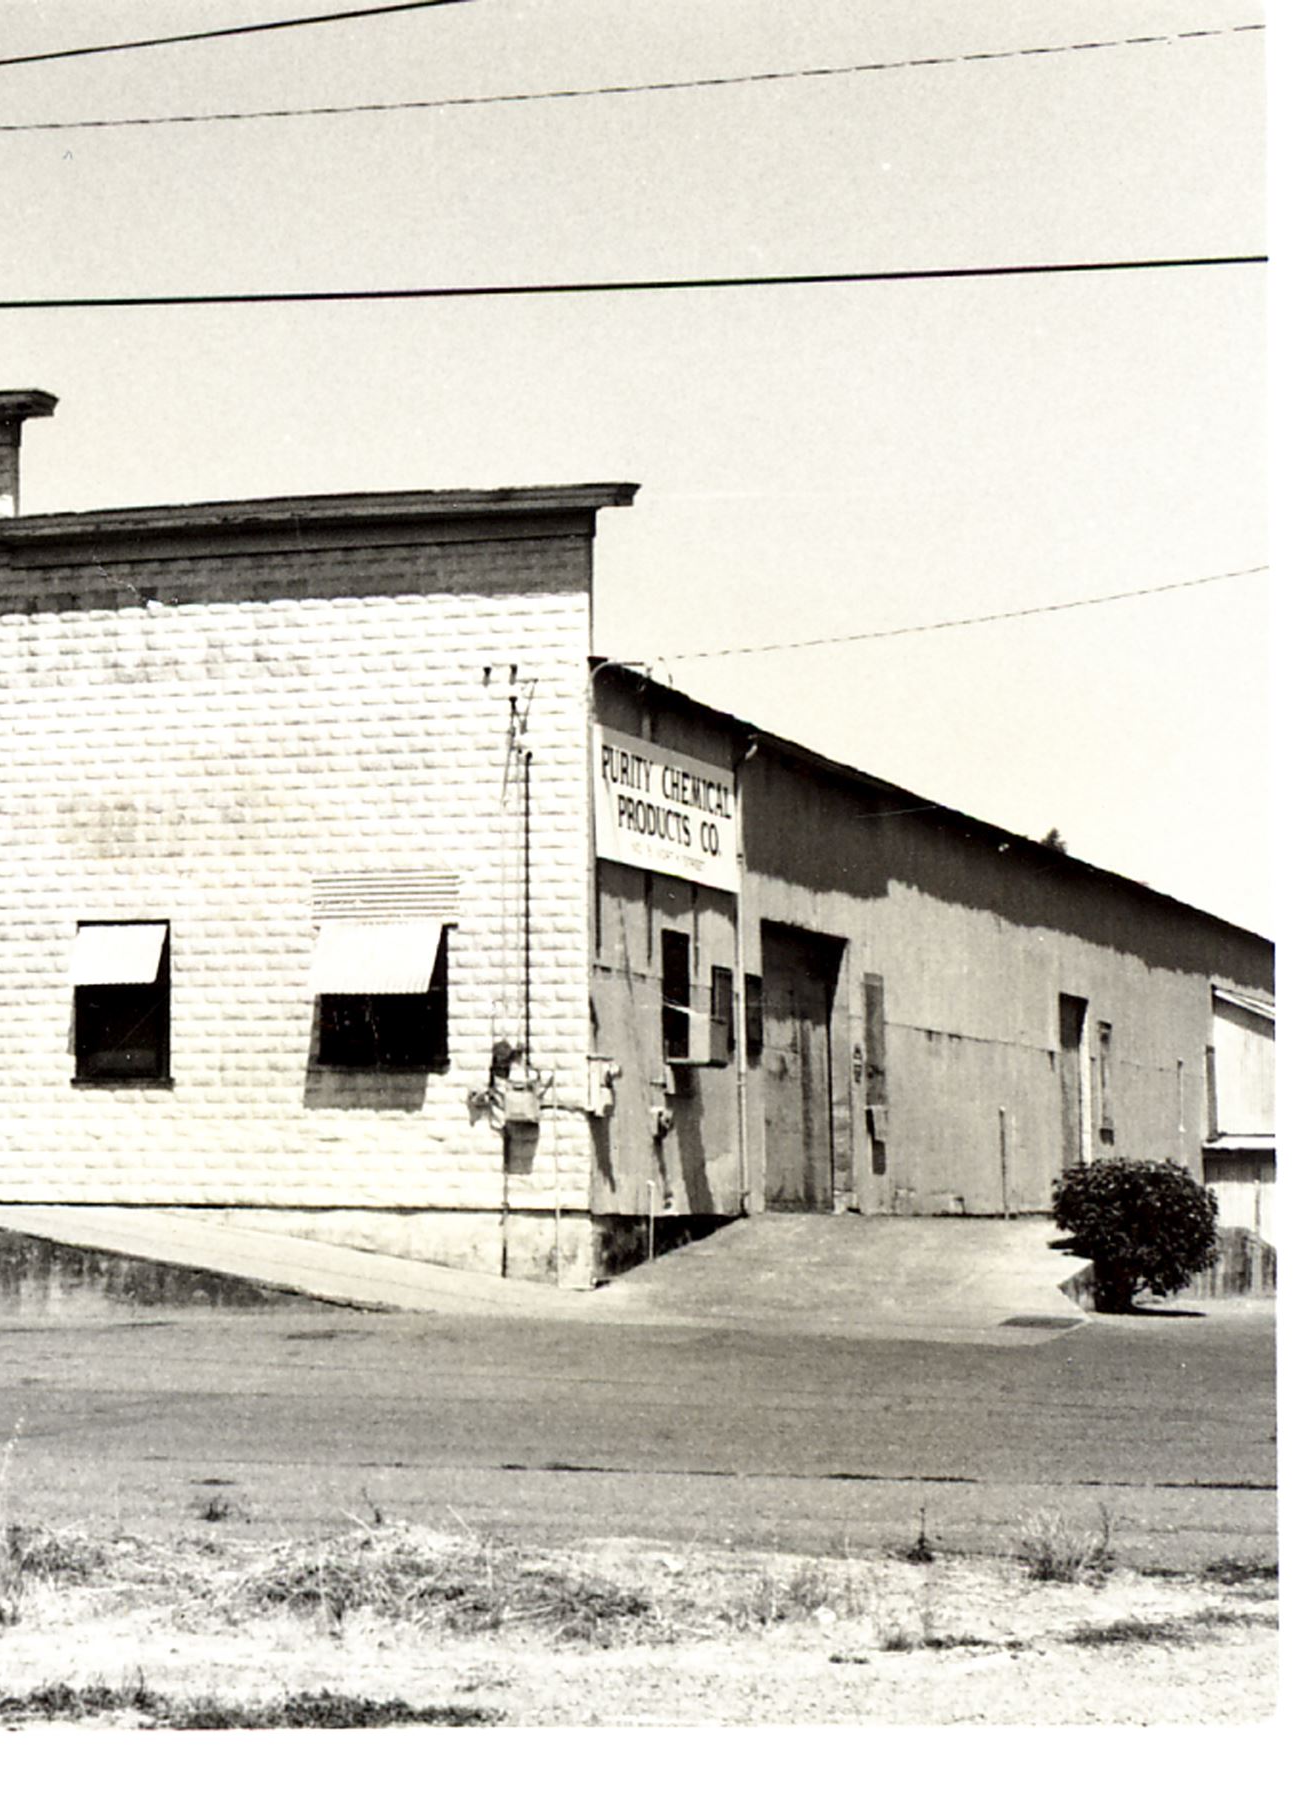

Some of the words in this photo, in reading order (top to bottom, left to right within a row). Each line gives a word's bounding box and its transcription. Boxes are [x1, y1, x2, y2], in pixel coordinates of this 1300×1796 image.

[601, 744, 654, 793] PURITY
[662, 765, 732, 820] CHEMICAL
[617, 793, 692, 847] PRODUCTS
